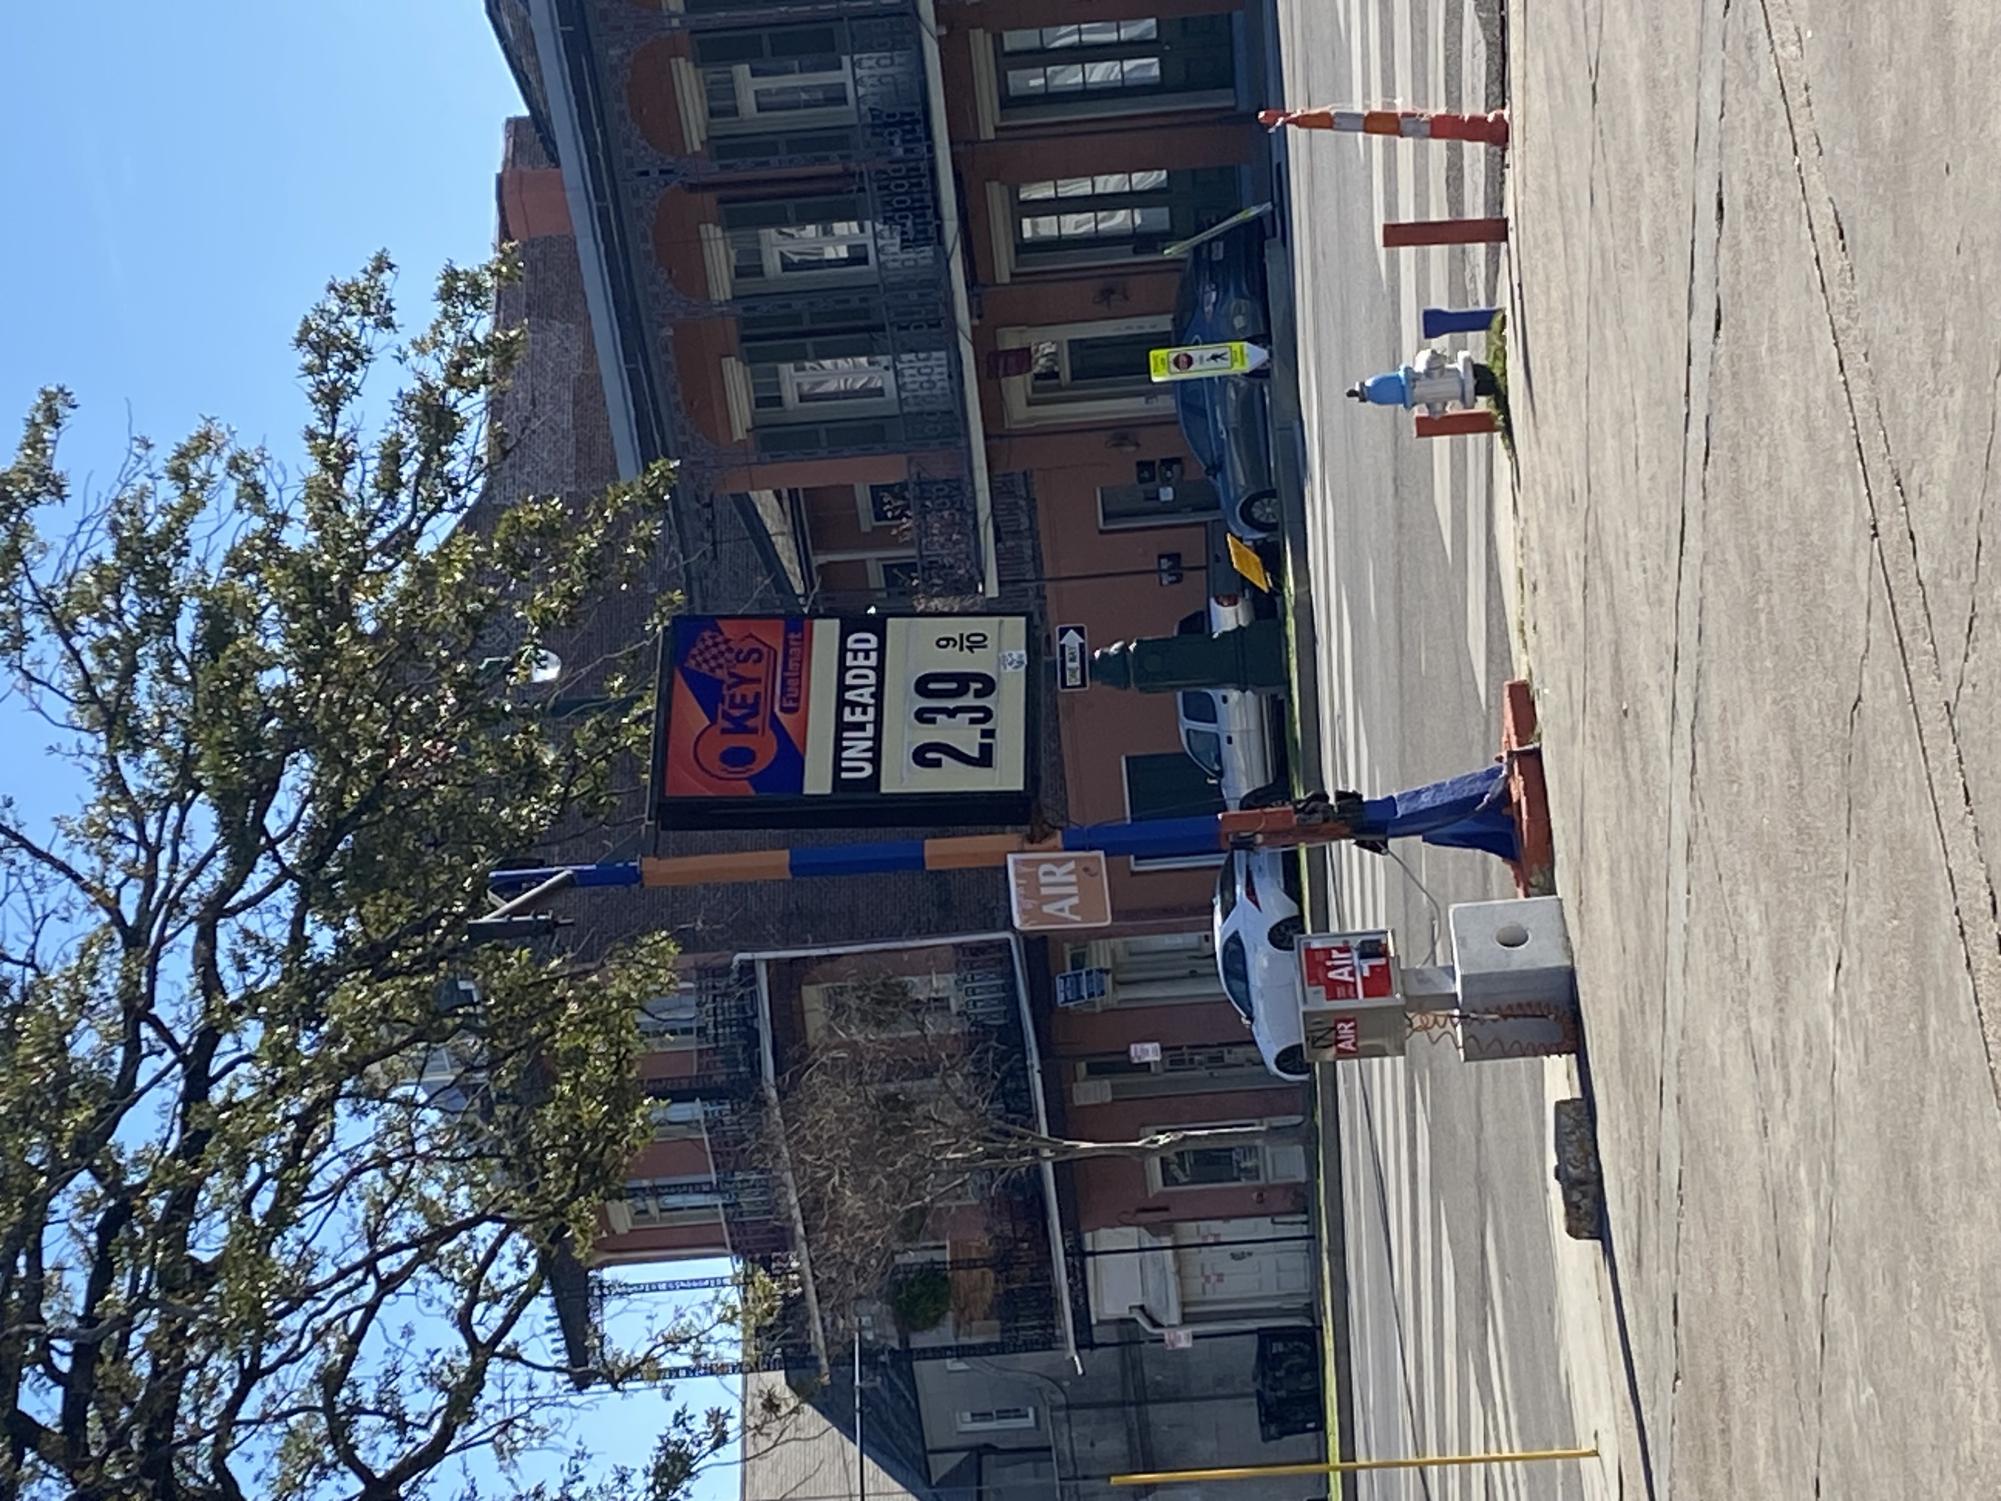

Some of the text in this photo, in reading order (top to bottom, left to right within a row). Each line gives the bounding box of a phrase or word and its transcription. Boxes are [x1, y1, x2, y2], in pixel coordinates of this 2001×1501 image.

[782, 631, 802, 708] Fuelmart
[840, 632, 878, 779] UNLEADED
[911, 672, 996, 769] 2.39
[1038, 859, 1081, 921] AIR
[1325, 949, 1355, 983] Air
[1336, 1021, 1356, 1051] AIR
